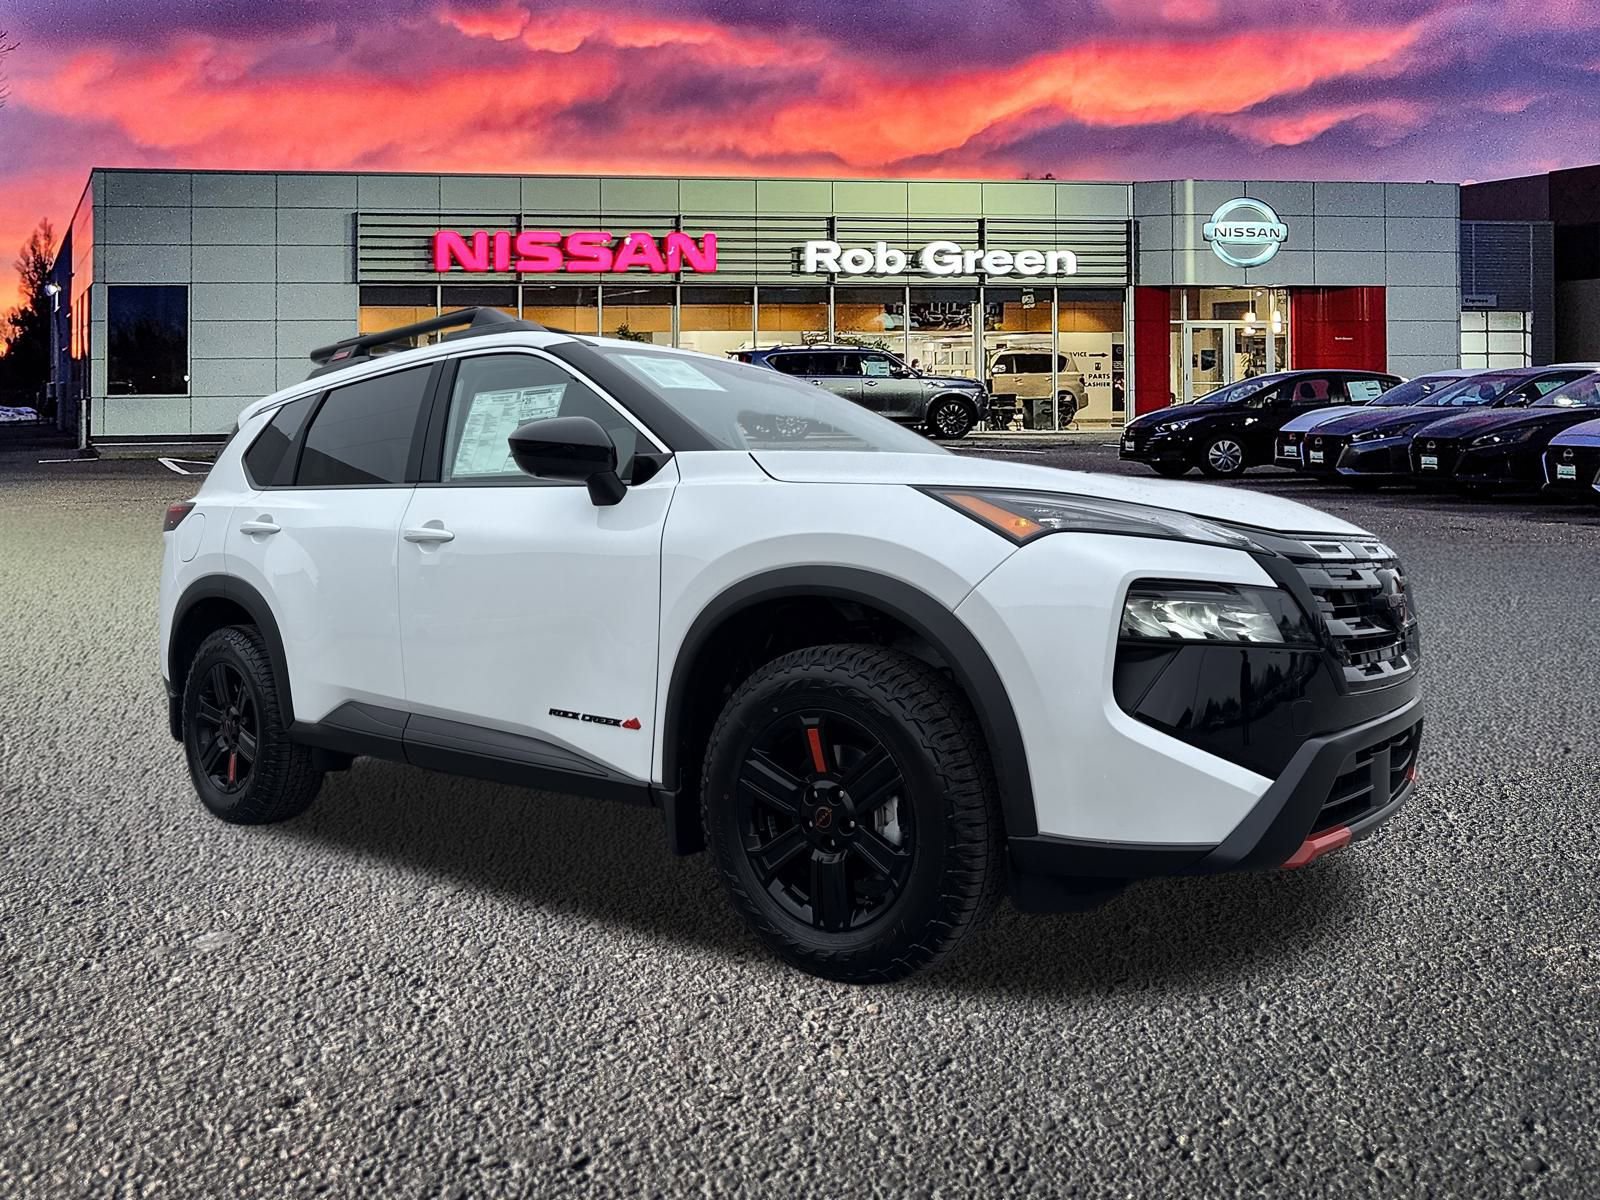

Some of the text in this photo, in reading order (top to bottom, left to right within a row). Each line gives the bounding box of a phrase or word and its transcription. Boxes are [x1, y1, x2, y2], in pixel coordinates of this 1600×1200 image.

[1214, 227, 1280, 238] NISSAN
[433, 230, 718, 273] NISSAN
[804, 240, 1077, 275] Rob Green
[548, 707, 622, 728] ROCK CREEK
